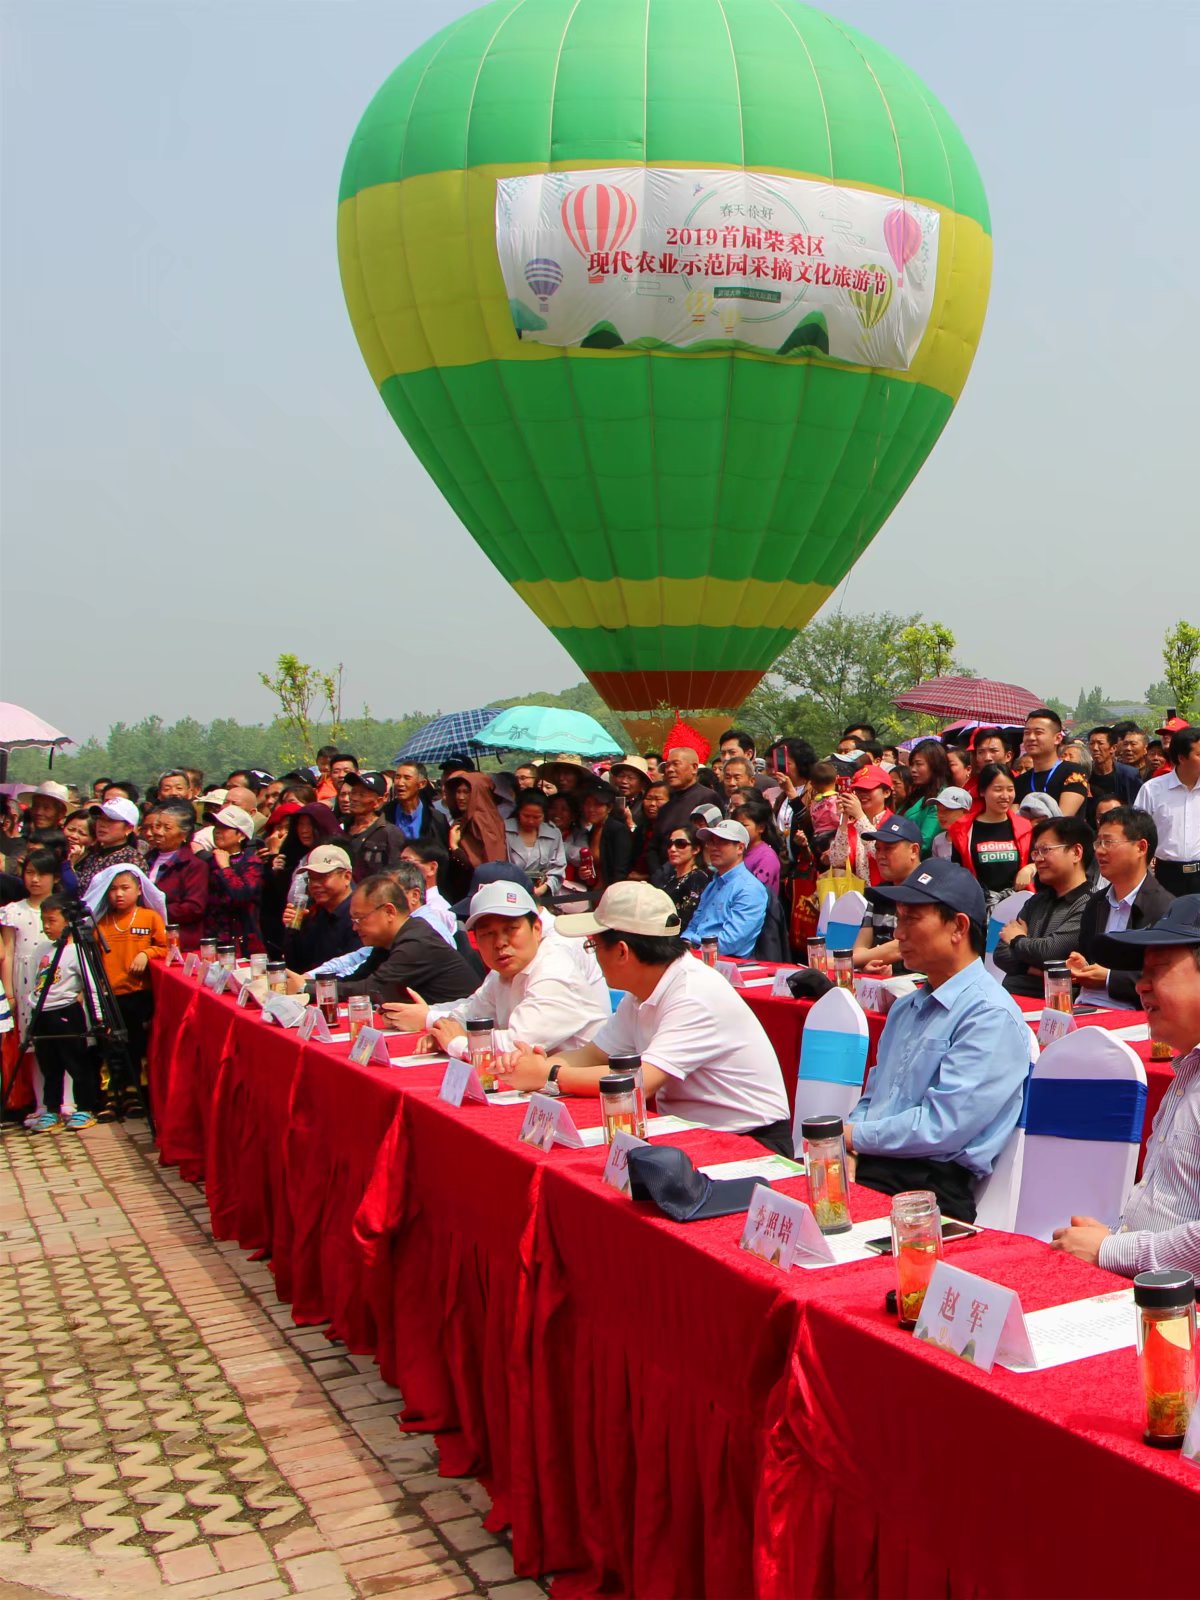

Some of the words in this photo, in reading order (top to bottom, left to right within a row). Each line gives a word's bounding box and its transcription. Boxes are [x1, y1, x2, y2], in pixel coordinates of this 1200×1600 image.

[666, 226, 825, 257] 2019首届柴桑区
[587, 250, 888, 294] 现代农业示范园采摘文化旅游节
[980, 843, 1014, 851] going
[981, 852, 1015, 863] going
[754, 1204, 793, 1246] 李照培
[937, 1286, 989, 1333] 赵军
